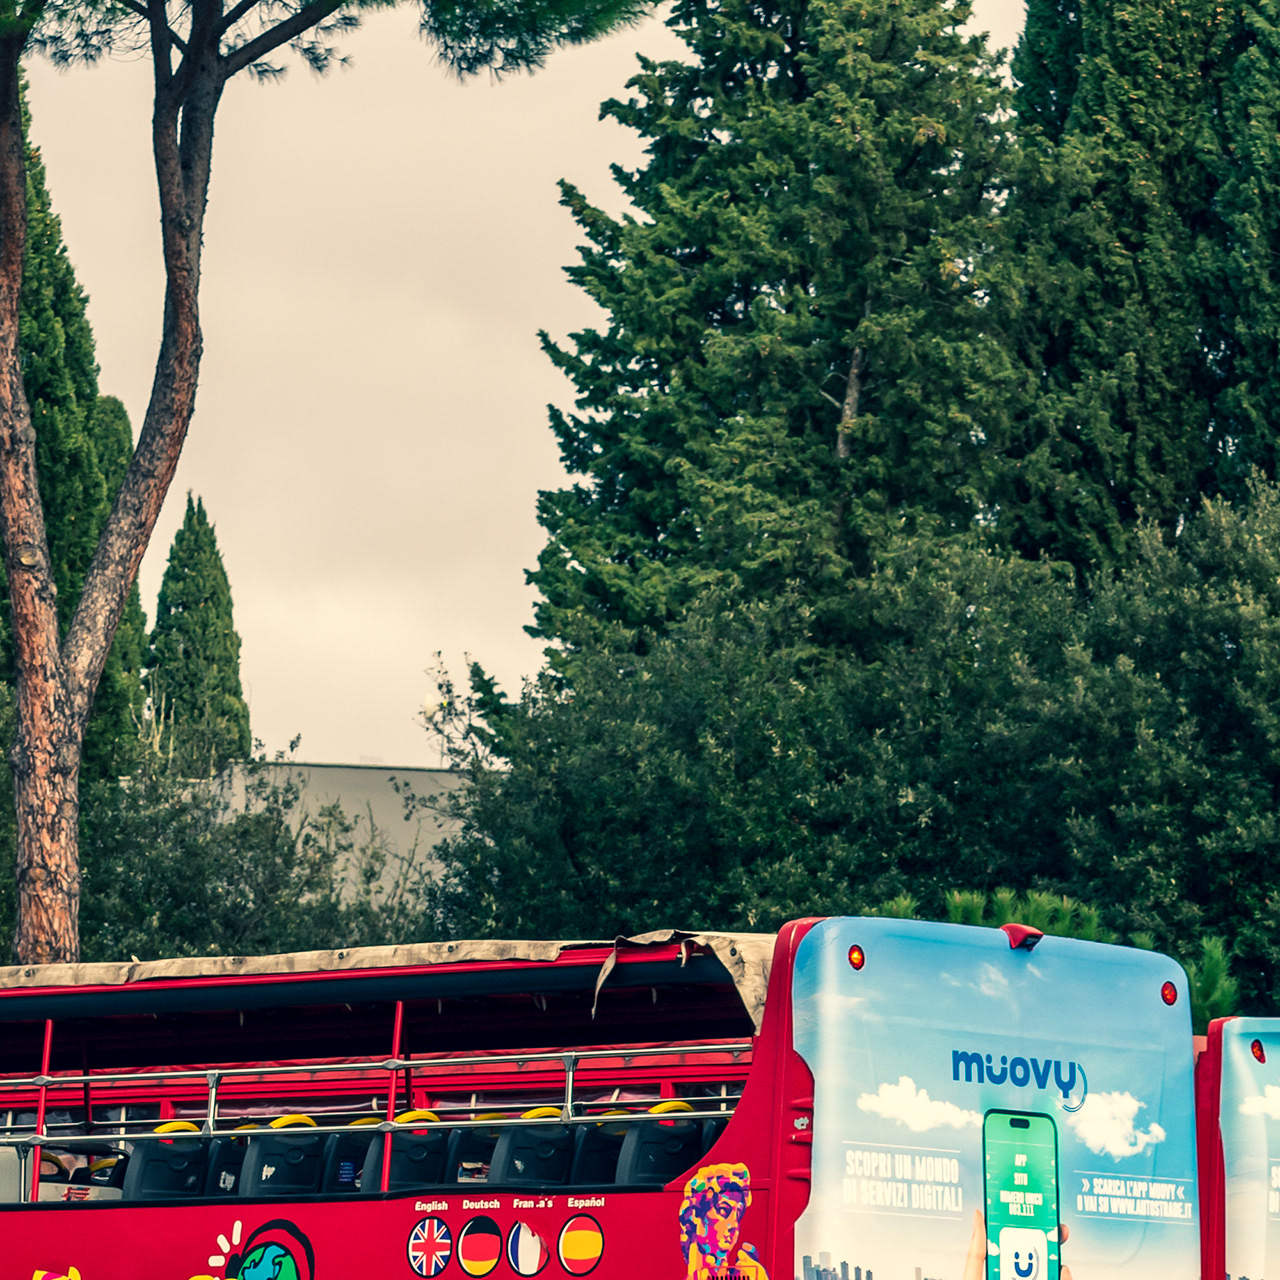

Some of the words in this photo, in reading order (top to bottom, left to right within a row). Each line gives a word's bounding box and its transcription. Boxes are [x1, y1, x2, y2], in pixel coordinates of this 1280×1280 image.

[845, 1149, 892, 1178] SCOPRI
[894, 1154, 912, 1180] UN
[915, 1155, 959, 1184] MONDO
[842, 1178, 857, 1204] DI
[860, 1179, 908, 1208] SERVIZI
[911, 1183, 963, 1212] DIGITALI
[1093, 1178, 1126, 1196] SCARICA
[415, 1201, 448, 1213] English
[462, 1199, 500, 1210] Deutsch
[513, 1197, 553, 1208] Franas
[567, 1197, 605, 1209] Español
[1083, 1195, 1098, 1212] VAI
[1098, 1196, 1109, 1213] SU
[1110, 1197, 1192, 1219] WWW.AUTOSTRADE.IT
[1269, 1190, 1279, 1213] DI
